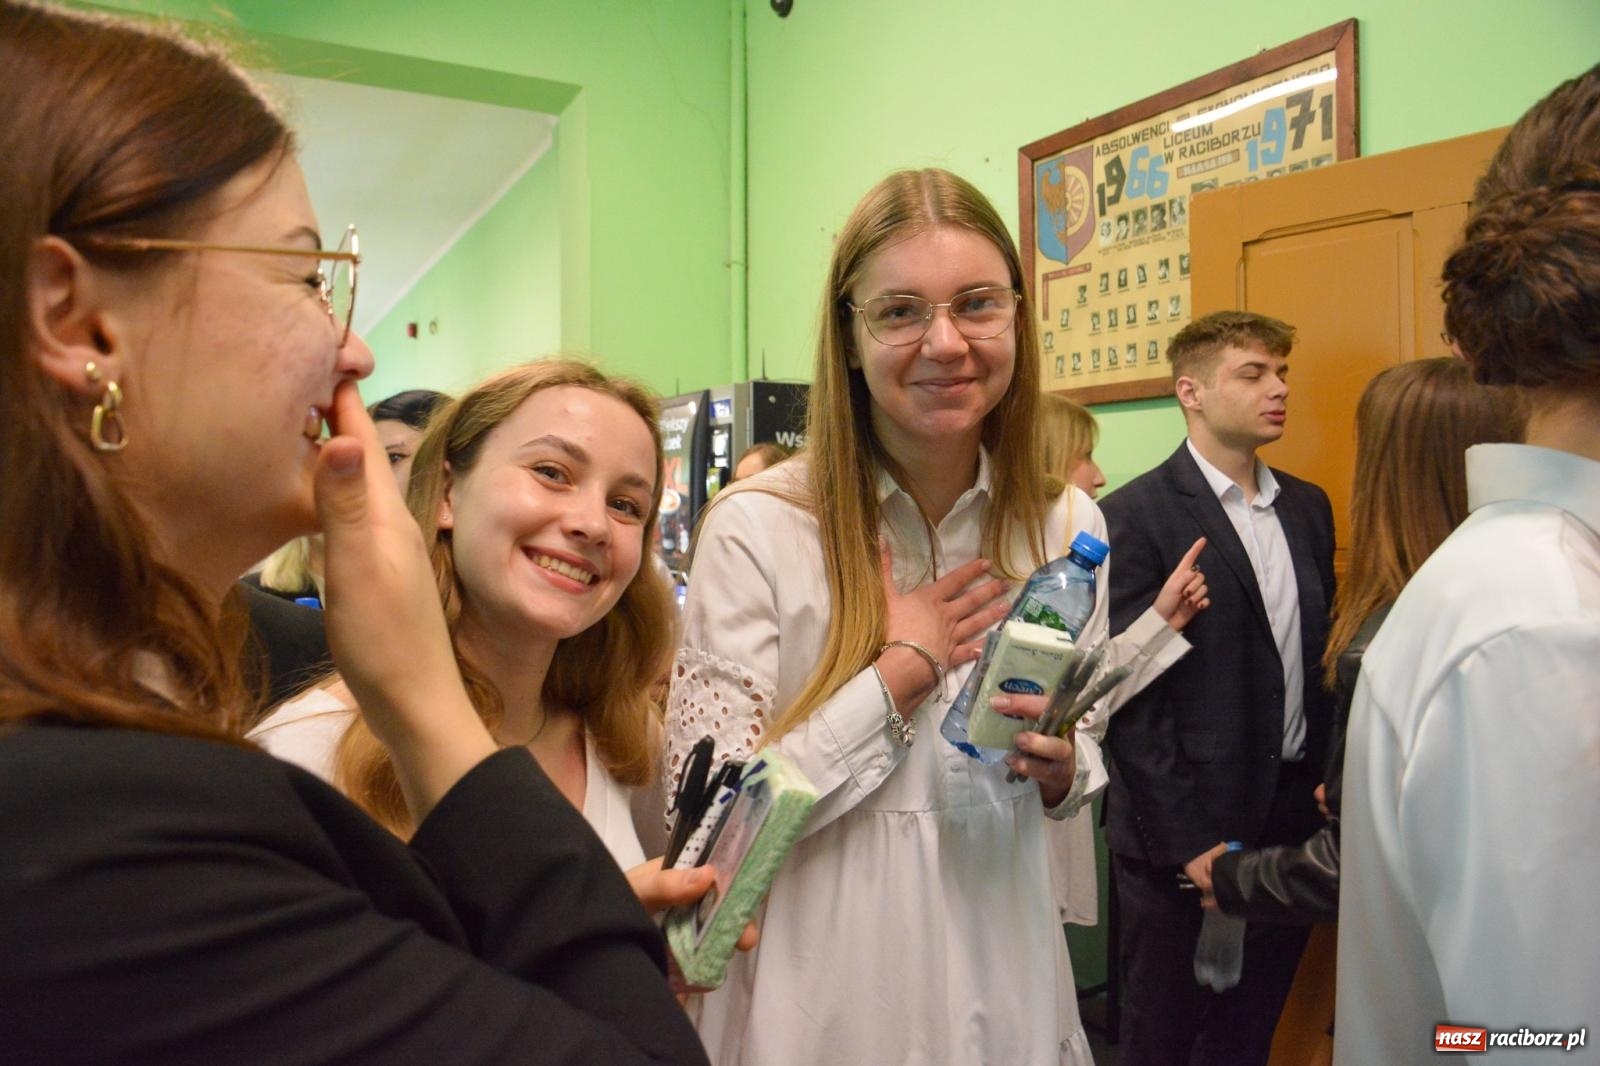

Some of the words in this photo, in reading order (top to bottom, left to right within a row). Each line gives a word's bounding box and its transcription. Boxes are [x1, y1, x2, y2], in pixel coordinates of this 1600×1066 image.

[1095, 121, 1170, 157] ABSOLWENCI
[1163, 121, 1213, 149] LICEUM
[1164, 149, 1175, 165] W
[1179, 121, 1261, 161] RACIBORZU
[1245, 88, 1334, 172] 1971
[1096, 145, 1169, 217] 1966
